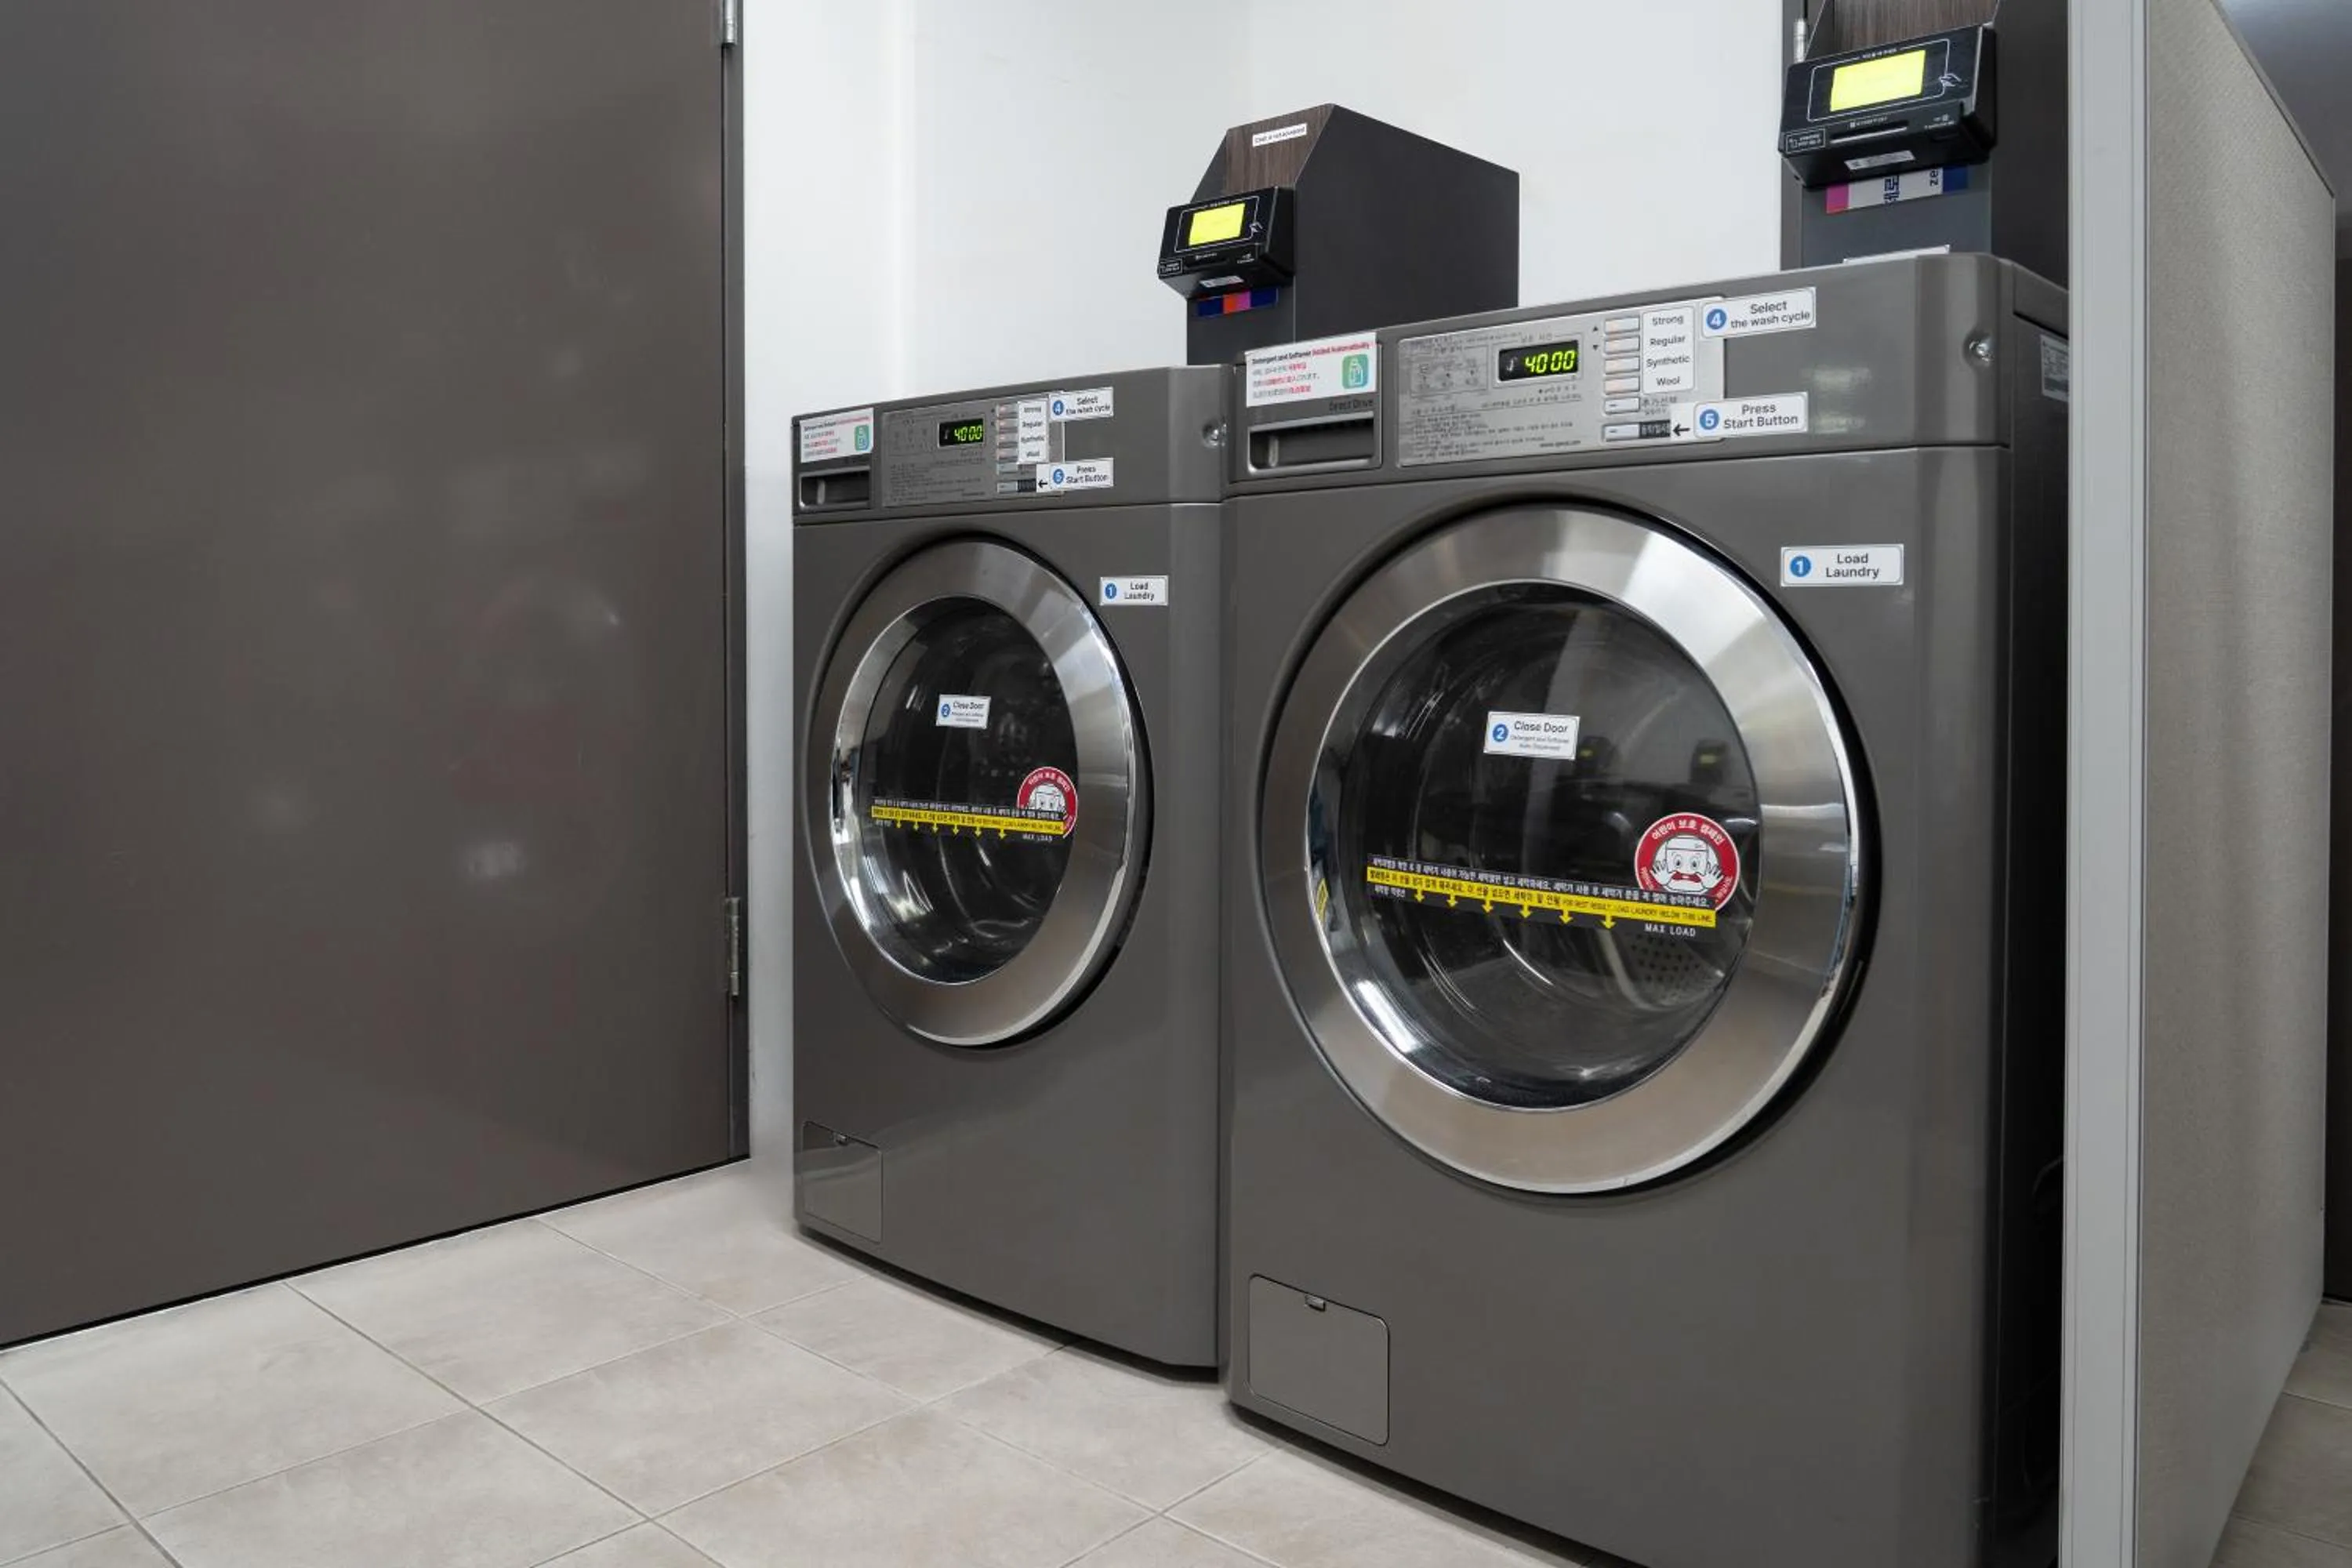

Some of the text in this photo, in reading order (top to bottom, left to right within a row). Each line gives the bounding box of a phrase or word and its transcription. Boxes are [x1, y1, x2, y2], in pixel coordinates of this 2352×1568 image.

[1750, 301, 1787, 314] Select
[1652, 315, 1683, 326] Strong
[1730, 311, 1810, 328] the wash cycle
[1650, 336, 1686, 347] Regular
[1525, 350, 1575, 373] 4000
[1646, 355, 1690, 368] Synthetic
[1656, 376, 1680, 386] Wool
[1076, 397, 1098, 405] Select
[1742, 404, 1777, 415] Press
[1724, 416, 1798, 429] Start Button
[954, 424, 982, 441] 4000
[1837, 554, 1869, 564] Load
[1825, 567, 1880, 580] Laundry
[1130, 581, 1149, 590] Load
[1123, 591, 1155, 601] Laundry
[1514, 720, 1569, 733] Close Door
[1652, 821, 1677, 840] 어린이
[1679, 819, 1697, 829] 보호
[1644, 923, 1697, 938] MAX LOAD
